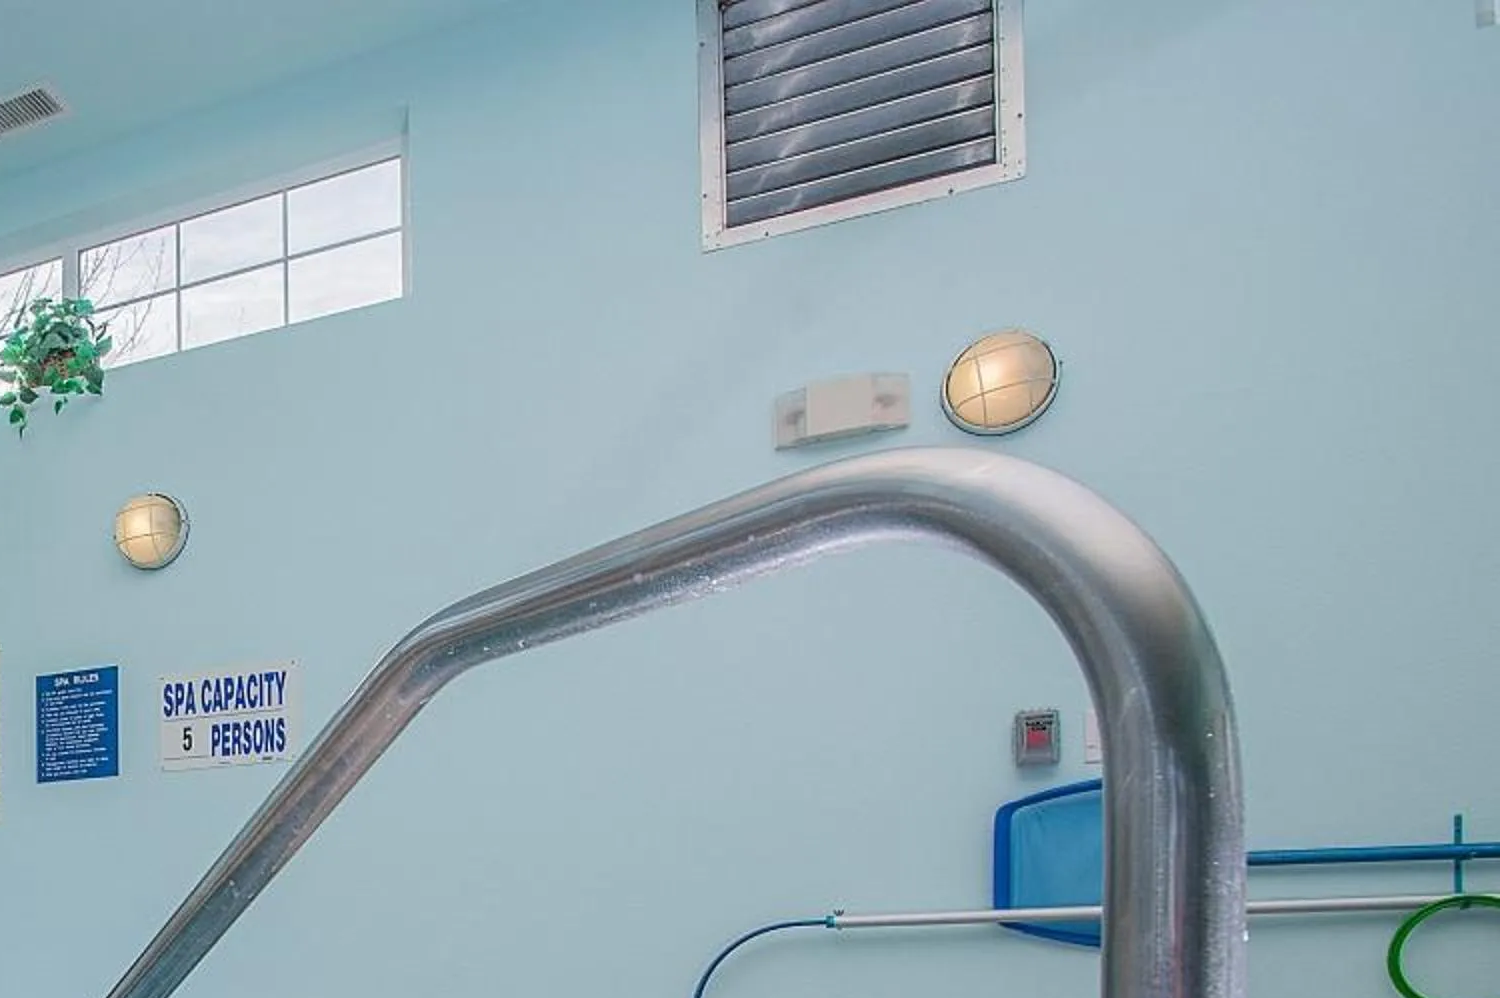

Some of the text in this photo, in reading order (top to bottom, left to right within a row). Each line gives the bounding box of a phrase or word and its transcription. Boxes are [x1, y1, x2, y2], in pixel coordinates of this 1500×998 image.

[163, 670, 287, 718] SPA CAPACITY
[182, 717, 287, 757] 5 PERSONS
